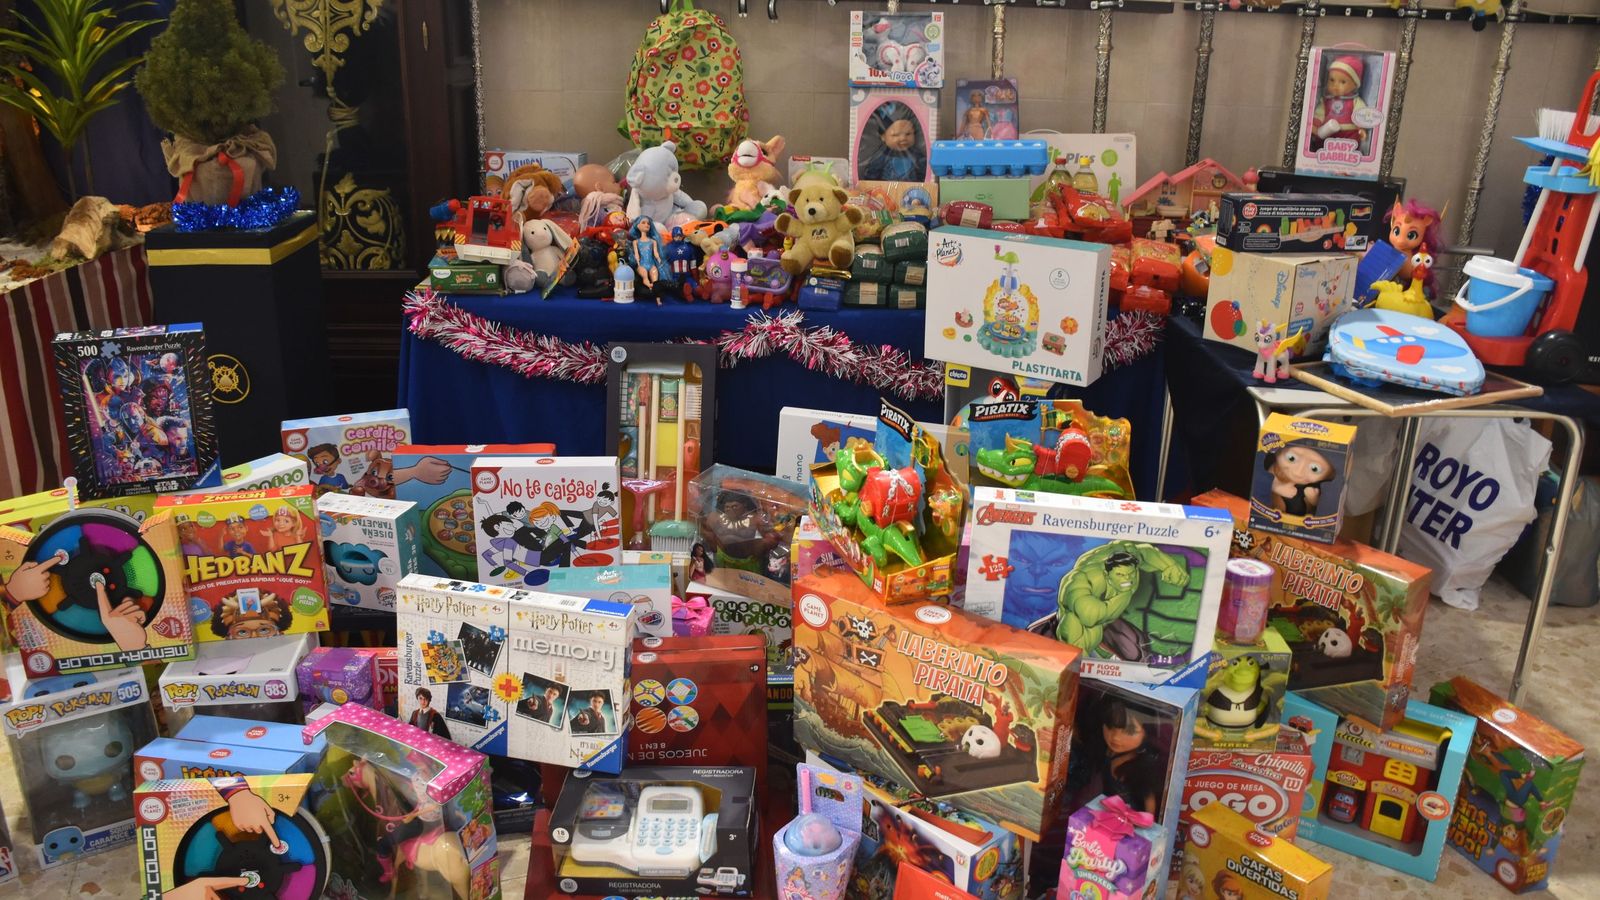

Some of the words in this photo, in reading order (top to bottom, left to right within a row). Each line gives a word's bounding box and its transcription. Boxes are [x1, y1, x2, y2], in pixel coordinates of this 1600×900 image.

[1327, 142, 1355, 151] BABY
[1065, 152, 1096, 165] Pls
[1319, 152, 1359, 163] BABBLES
[942, 238, 957, 248] Art
[936, 248, 957, 260] Planet
[77, 345, 98, 357] 500
[126, 344, 163, 352] Ravensburger
[1012, 361, 1082, 381] PLASTITARTA
[880, 403, 910, 433] PIRATIX
[975, 403, 1029, 417] PIRATIX
[501, 479, 522, 499] ¡No
[526, 479, 541, 499] te
[544, 478, 597, 503] caigas!
[352, 519, 393, 530] TARJETAS
[1042, 513, 1134, 535] Ravensburger
[1137, 522, 1179, 538] Puzzle
[1204, 526, 1221, 538] 6+
[362, 528, 393, 539] DISEÑA
[183, 542, 314, 584] HEDBANZ
[989, 563, 1004, 573] 125
[1271, 543, 1364, 594] LABERINTO
[216, 577, 250, 586] PREGUNTAS
[1282, 570, 1343, 611] PIRATA
[416, 595, 445, 614] Harry
[446, 597, 477, 617] Potter
[715, 599, 790, 615] gusani
[803, 608, 825, 619] PLANET
[806, 602, 822, 612] GAME
[530, 612, 560, 630] Harry
[562, 618, 594, 637] Potter
[609, 621, 619, 629] 4+
[119, 646, 188, 664] MEMORY
[404, 631, 415, 685] Ravensburger
[514, 636, 617, 670] memory
[897, 630, 1008, 687] LABERINTO
[1157, 655, 1172, 664] 1:1
[58, 655, 114, 669] COLOR
[413, 661, 422, 686] Puzzle
[1096, 669, 1121, 677] PUZZLE
[1169, 657, 1208, 685] Ravensburger
[117, 685, 140, 701] 505
[163, 682, 199, 699] POP!
[265, 684, 287, 697] 583
[913, 663, 986, 706] PIRATA
[5, 704, 45, 726] POP!
[476, 726, 505, 750] Ravensburger
[586, 743, 618, 768] Ravensburger
[639, 751, 655, 760] DE
[658, 748, 708, 760] JUEGOS
[1195, 781, 1224, 789] JUEGO
[1227, 782, 1238, 790] DE
[1241, 784, 1264, 792] MESA
[278, 794, 291, 802] 3+
[1181, 790, 1277, 817] OGO
[89, 830, 130, 848] CARAPUCE
[1071, 829, 1104, 858] Barbie
[143, 827, 160, 885] COLOR
[1067, 847, 1127, 879] Party
[1241, 855, 1283, 882] GAFAS
[1077, 870, 1113, 890] UNBOXED
[1226, 859, 1298, 900] DIVERTIDAS
